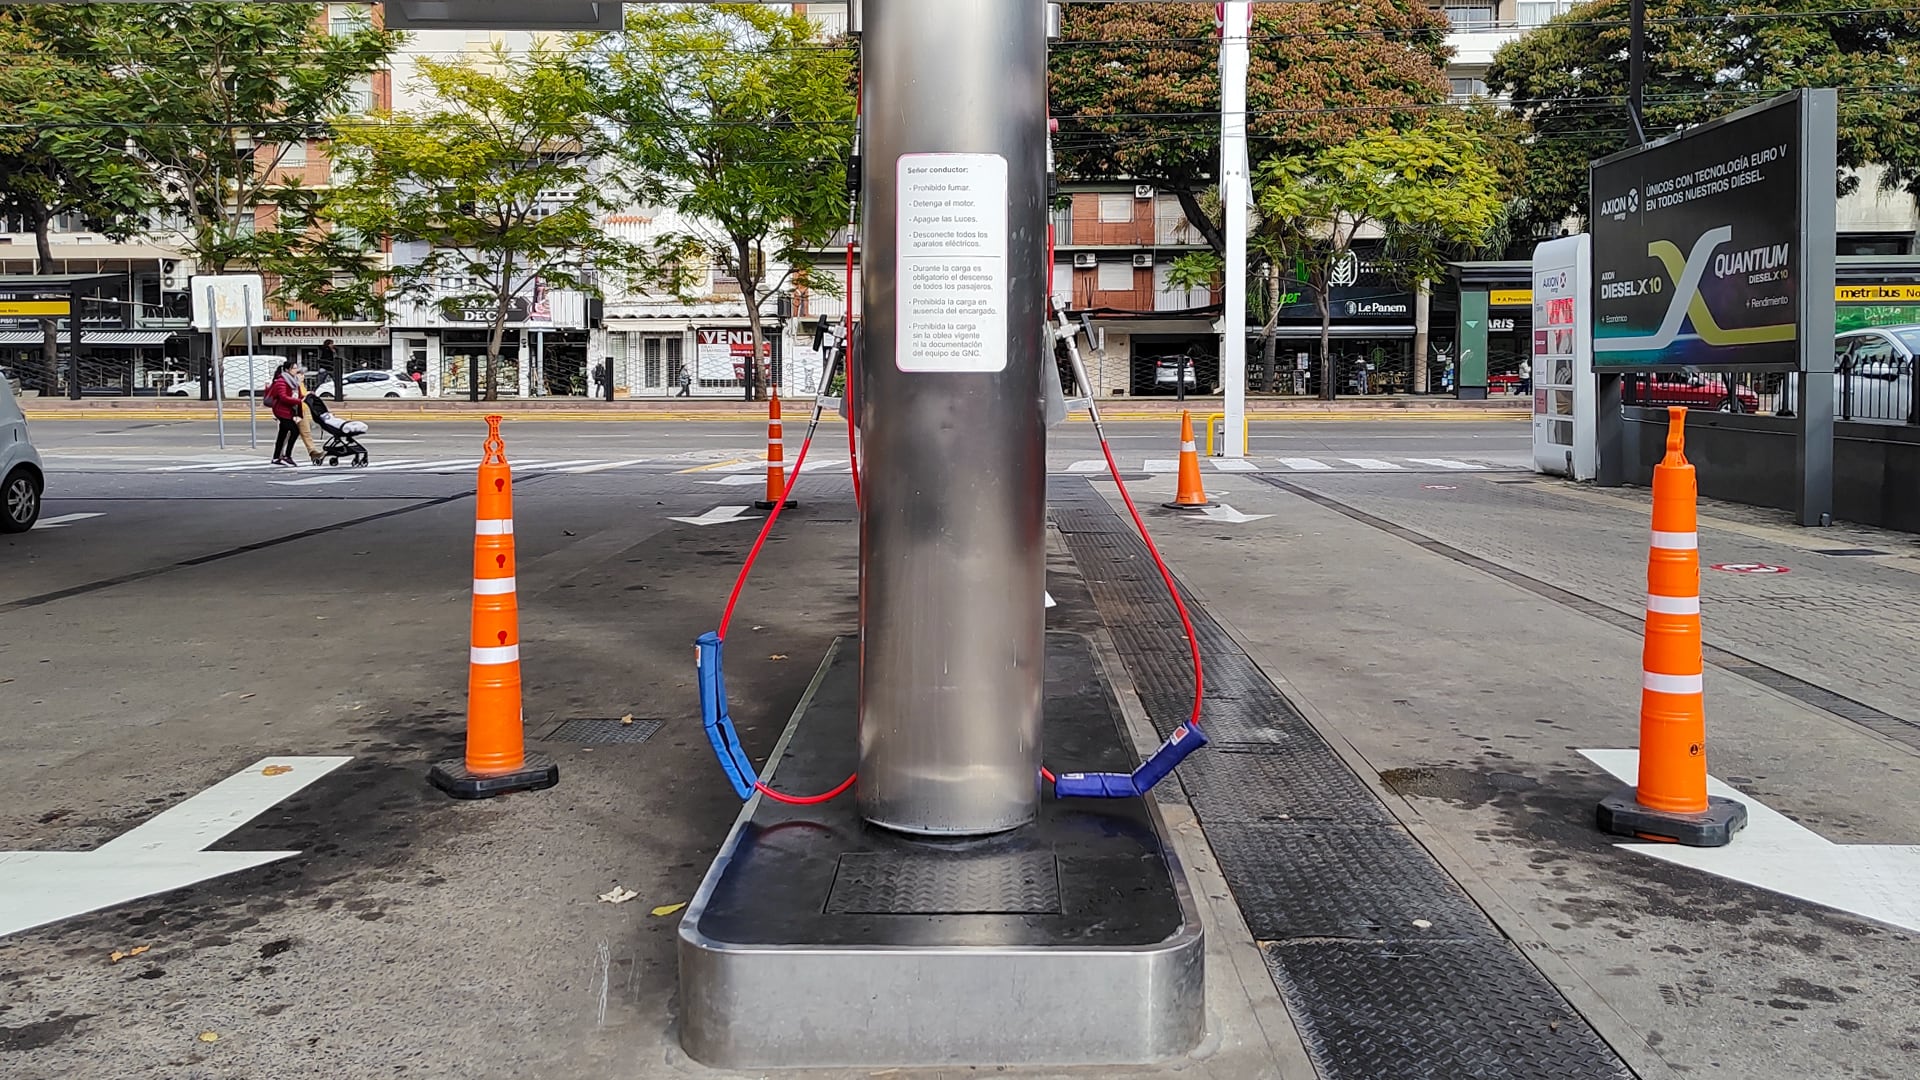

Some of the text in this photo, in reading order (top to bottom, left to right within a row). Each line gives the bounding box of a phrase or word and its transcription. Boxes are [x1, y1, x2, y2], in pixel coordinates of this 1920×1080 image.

[929, 166, 969, 174] conductor:
[1645, 144, 1787, 197] ÚNICOS CON TECNOLOGÍA EURO V
[912, 184, 971, 192] Prohibido fumar.
[1646, 169, 1766, 211] EN TODOS NUESTROS DIÉSEL.
[912, 199, 976, 208] Detenga el motor.
[1600, 196, 1626, 216] AXION
[912, 215, 978, 225] Apague las Luces.
[912, 231, 989, 239] Desconecte todos los
[912, 239, 981, 249] aparatos eléctricos.
[1714, 243, 1789, 279] QUANTIUM
[912, 264, 941, 272] Durante
[941, 264, 950, 272] la
[912, 273, 994, 282] obligatorio el descenso
[1748, 272, 1772, 284] DIESEL
[912, 282, 993, 292] de todos los pasajeros.
[1601, 280, 1637, 300] DIESEL
[912, 297, 946, 306] Prohibida
[947, 297, 955, 306] la
[955, 299, 977, 307] carga
[1751, 296, 1789, 308] Rendimiento
[912, 307, 998, 316] ausencia del encargado.
[1357, 302, 1407, 313] Le Panem
[274, 327, 343, 337] ARGENTINI
[912, 322, 977, 332] Prohibida la carga
[702, 331, 754, 345] VEND
[953, 332, 981, 341] vigente
[928, 340, 983, 348] documentación
[924, 350, 949, 359] equipo
